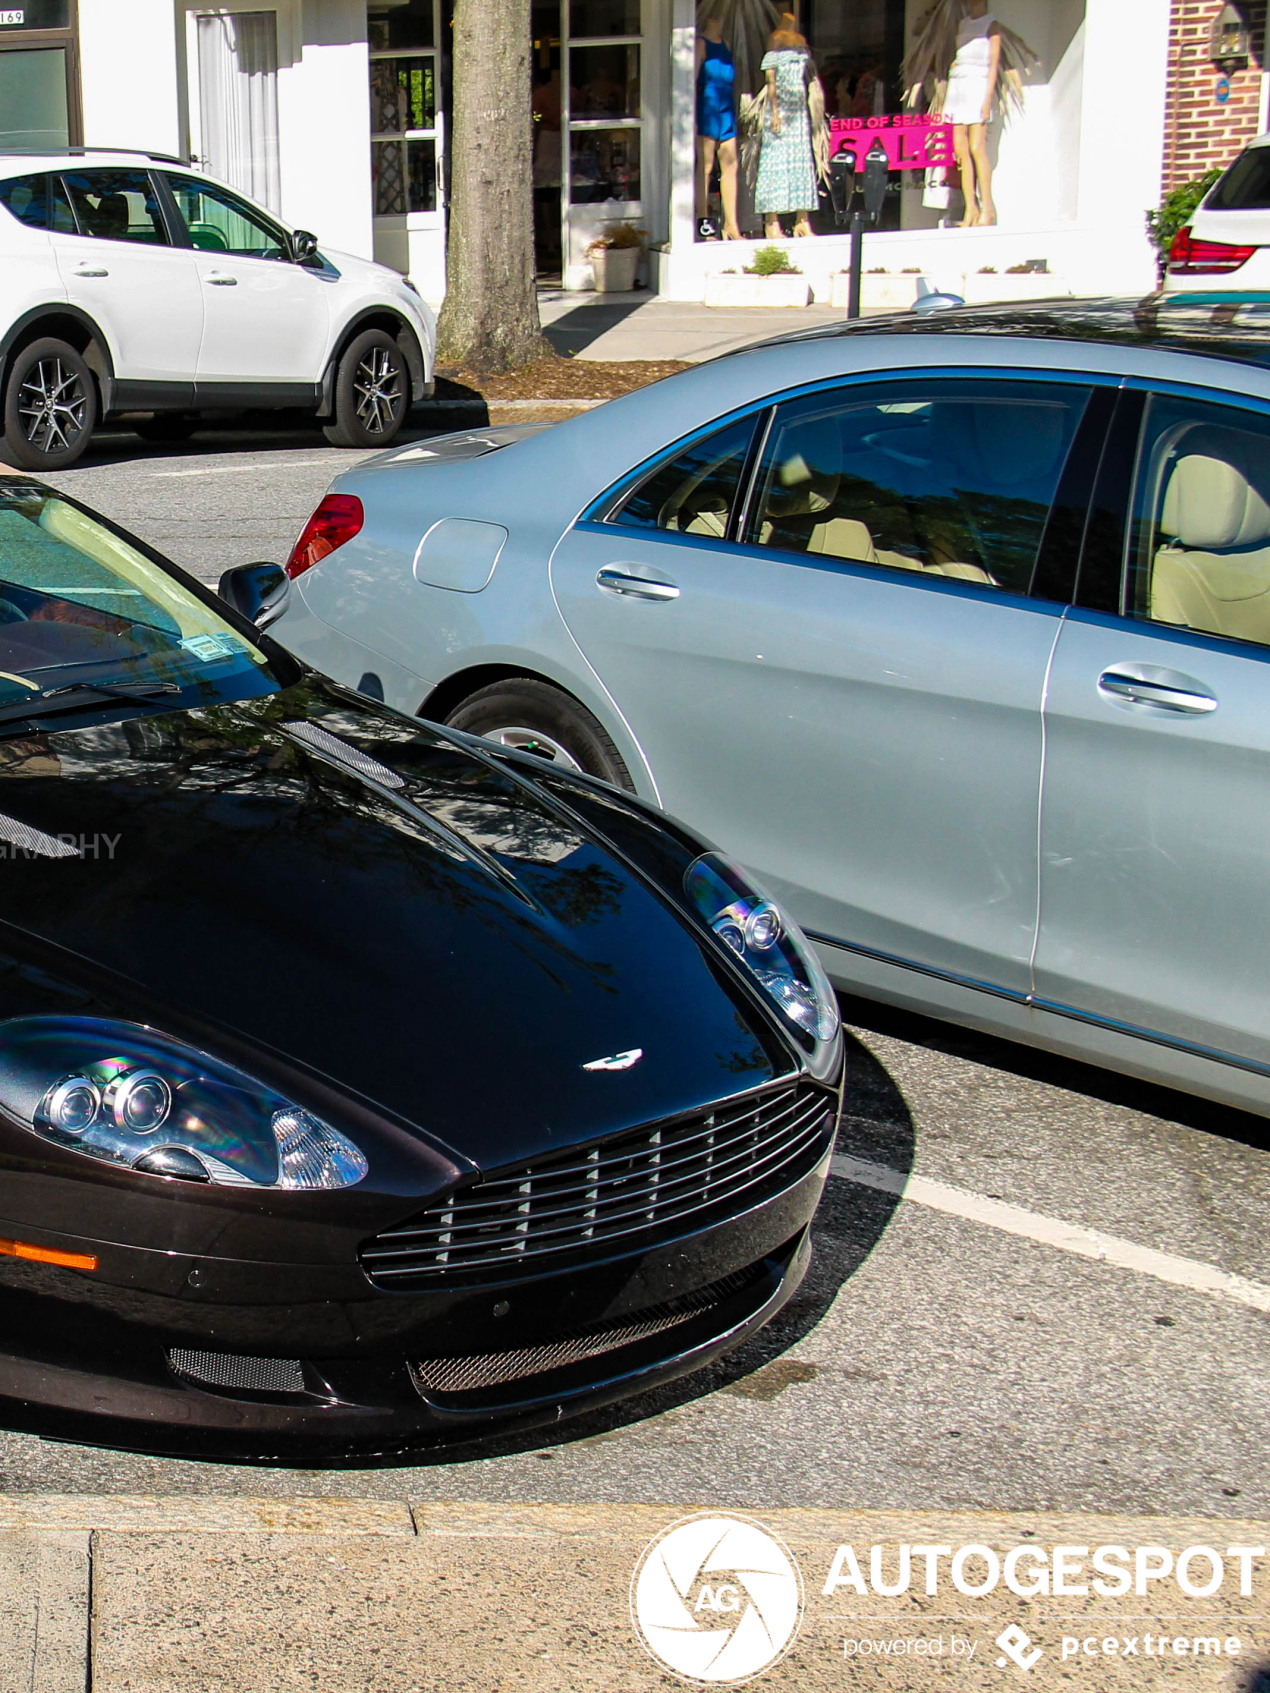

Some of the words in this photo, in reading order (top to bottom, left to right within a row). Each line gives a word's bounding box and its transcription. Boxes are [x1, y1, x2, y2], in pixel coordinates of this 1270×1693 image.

[1, 12, 22, 23] 169
[830, 118, 863, 131] END
[867, 116, 890, 128] OF
[892, 112, 954, 127] SEASON
[835, 132, 946, 164] SALE
